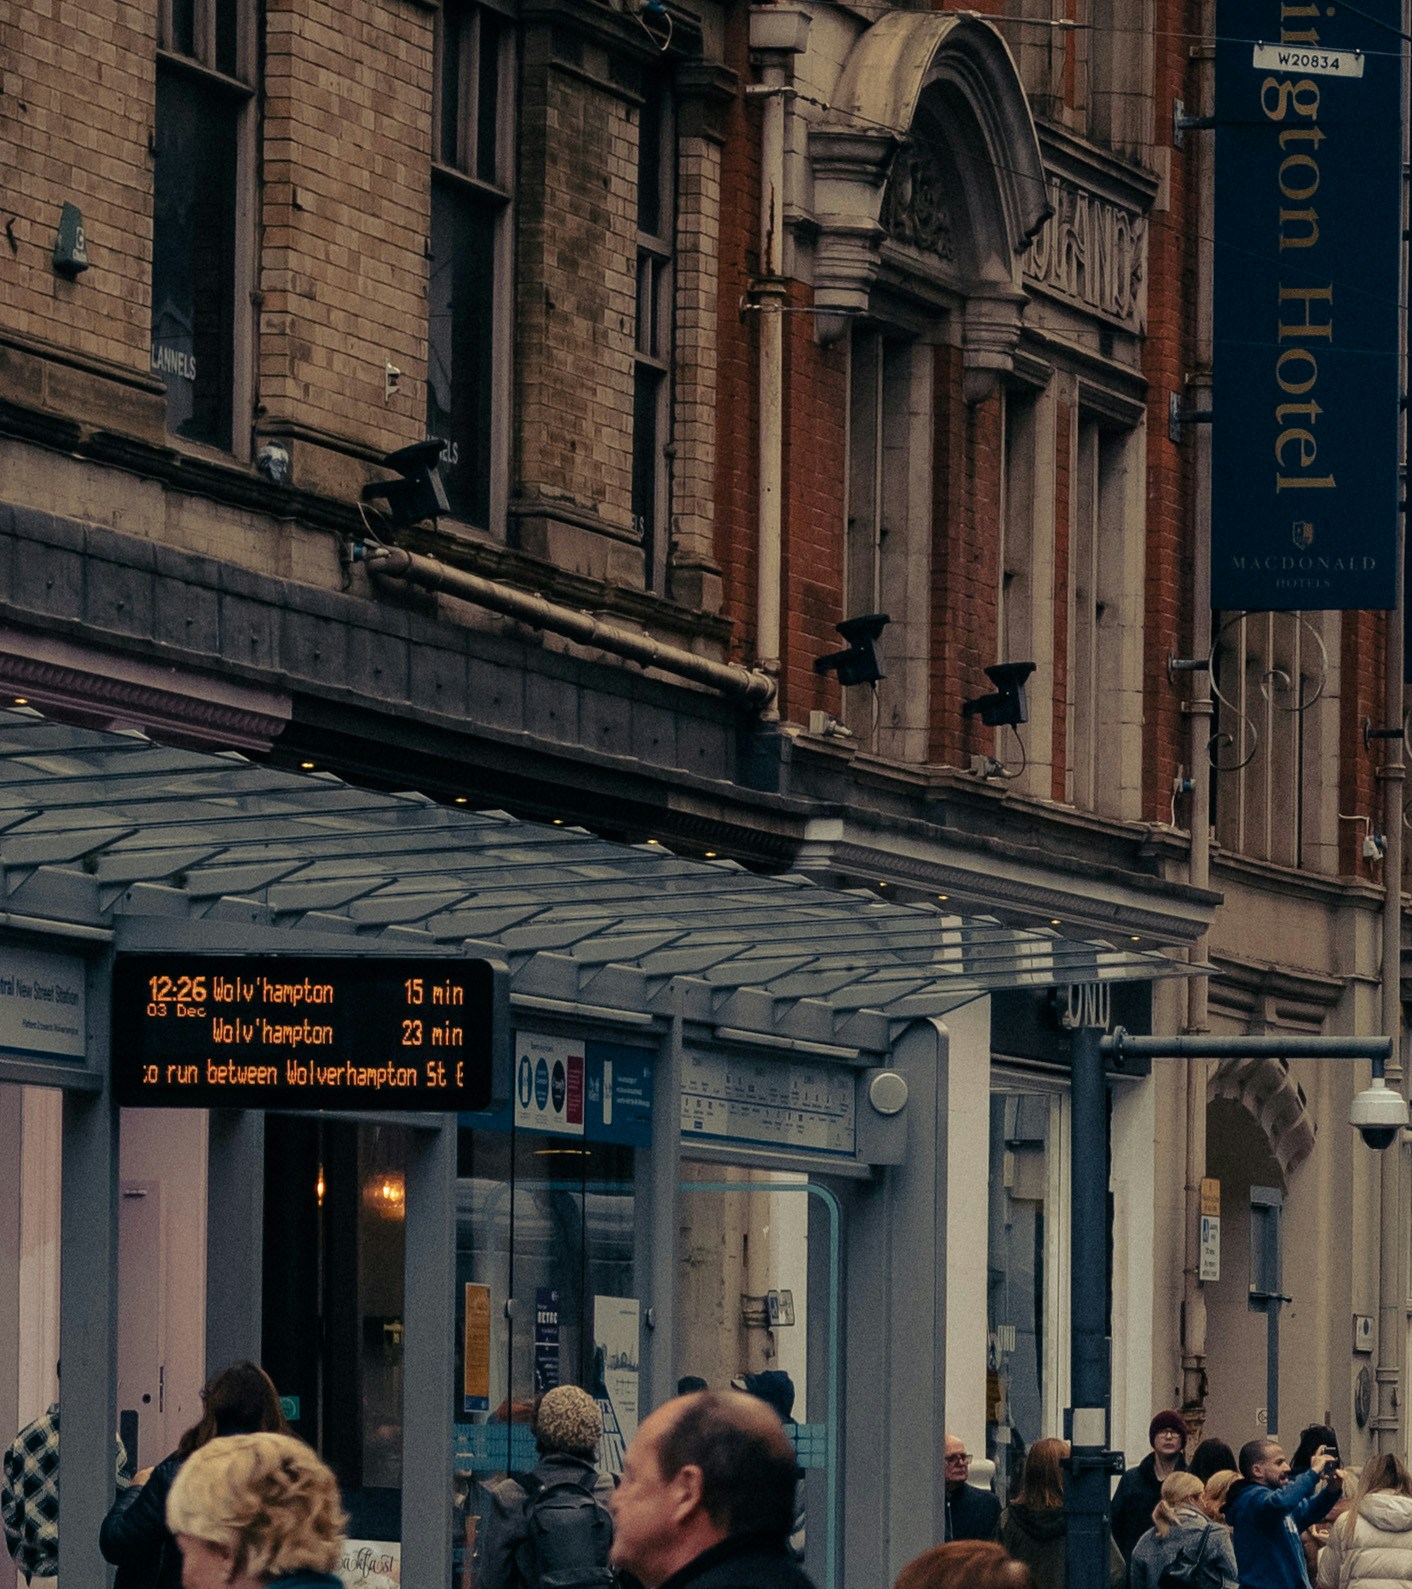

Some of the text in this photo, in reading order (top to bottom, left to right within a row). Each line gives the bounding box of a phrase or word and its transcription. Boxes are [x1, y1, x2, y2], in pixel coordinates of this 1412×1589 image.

[1278, 52, 1340, 70] W20834
[1274, 282, 1337, 495] Hotel
[1231, 555, 1376, 572] MACDONALD
[1276, 577, 1331, 589] HOTELS
[149, 976, 464, 1007] 12:26 Wolv'hampton 15 min
[147, 1003, 207, 1018] 03 Dec
[212, 1017, 463, 1048] Wolv'hampton 23 min
[167, 1064, 198, 1085] run
[207, 1059, 278, 1085] between
[286, 1060, 417, 1090] Wolverhampton
[426, 1061, 447, 1087] St
